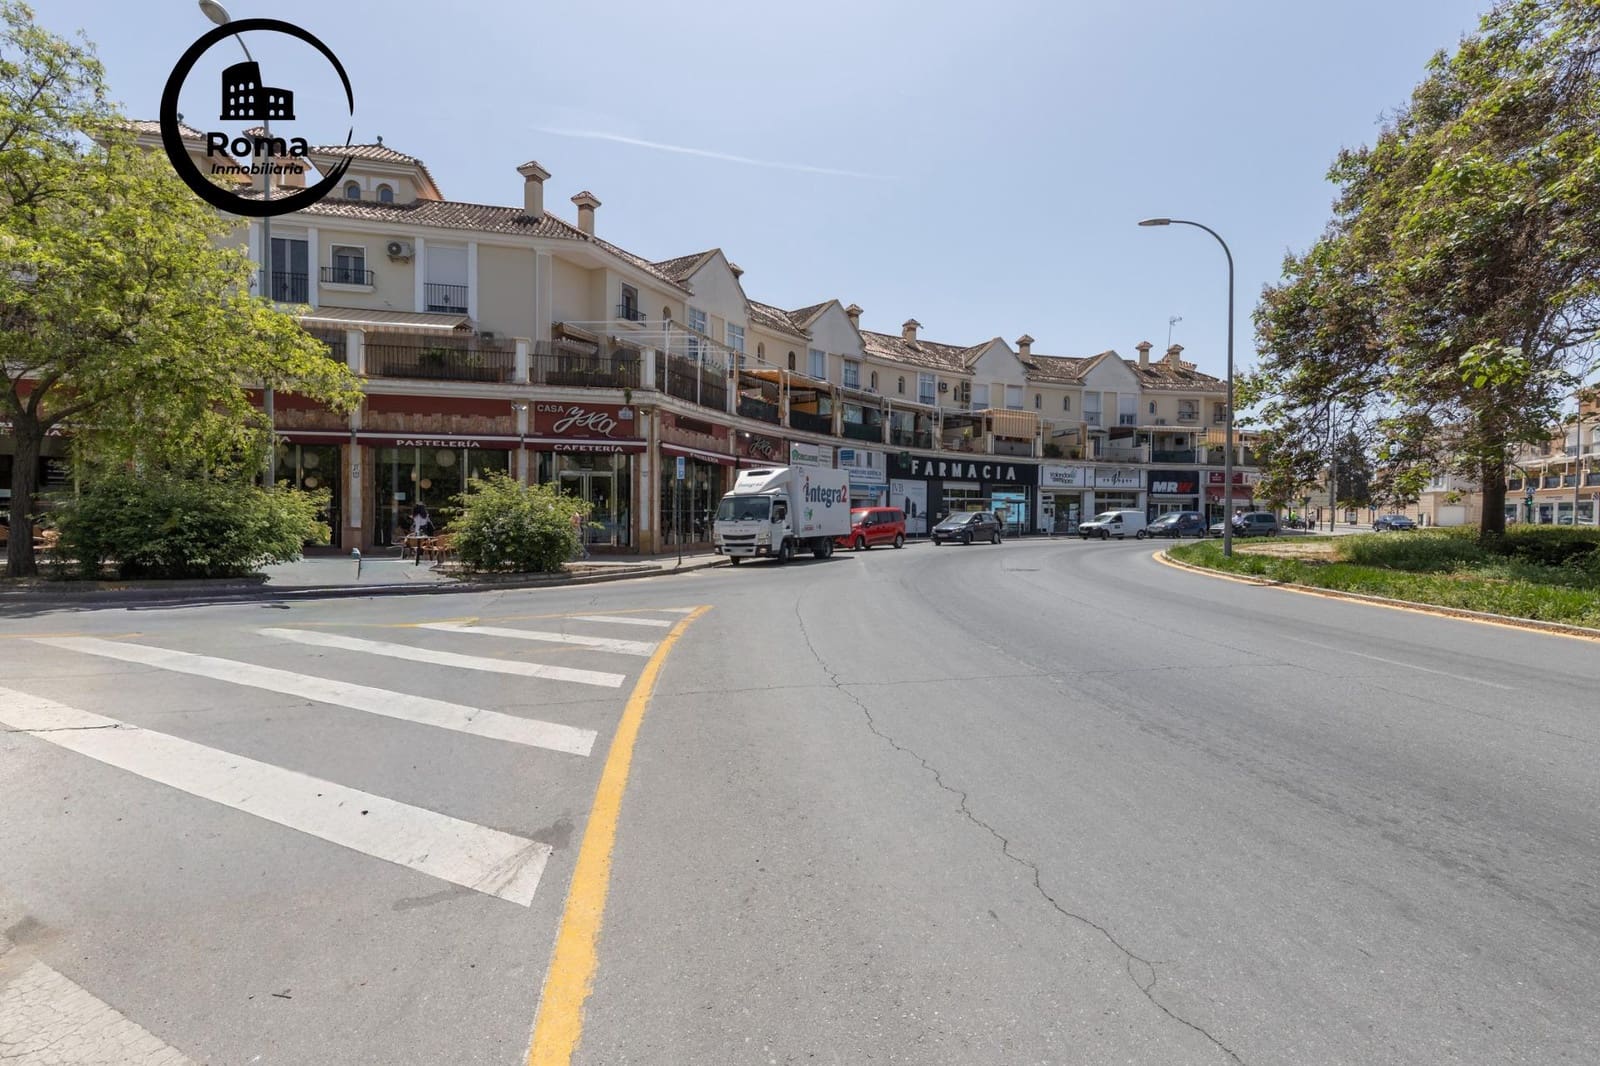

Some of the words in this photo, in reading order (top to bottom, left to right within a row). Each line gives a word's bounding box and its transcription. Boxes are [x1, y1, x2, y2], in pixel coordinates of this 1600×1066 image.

[537, 405, 564, 413] CASA
[396, 440, 480, 448] PASTELERÍA
[554, 444, 624, 452] CAFETERÍA
[911, 460, 1016, 480] FARMACIA
[803, 475, 848, 509] integra2
[1152, 481, 1192, 493] MRW
